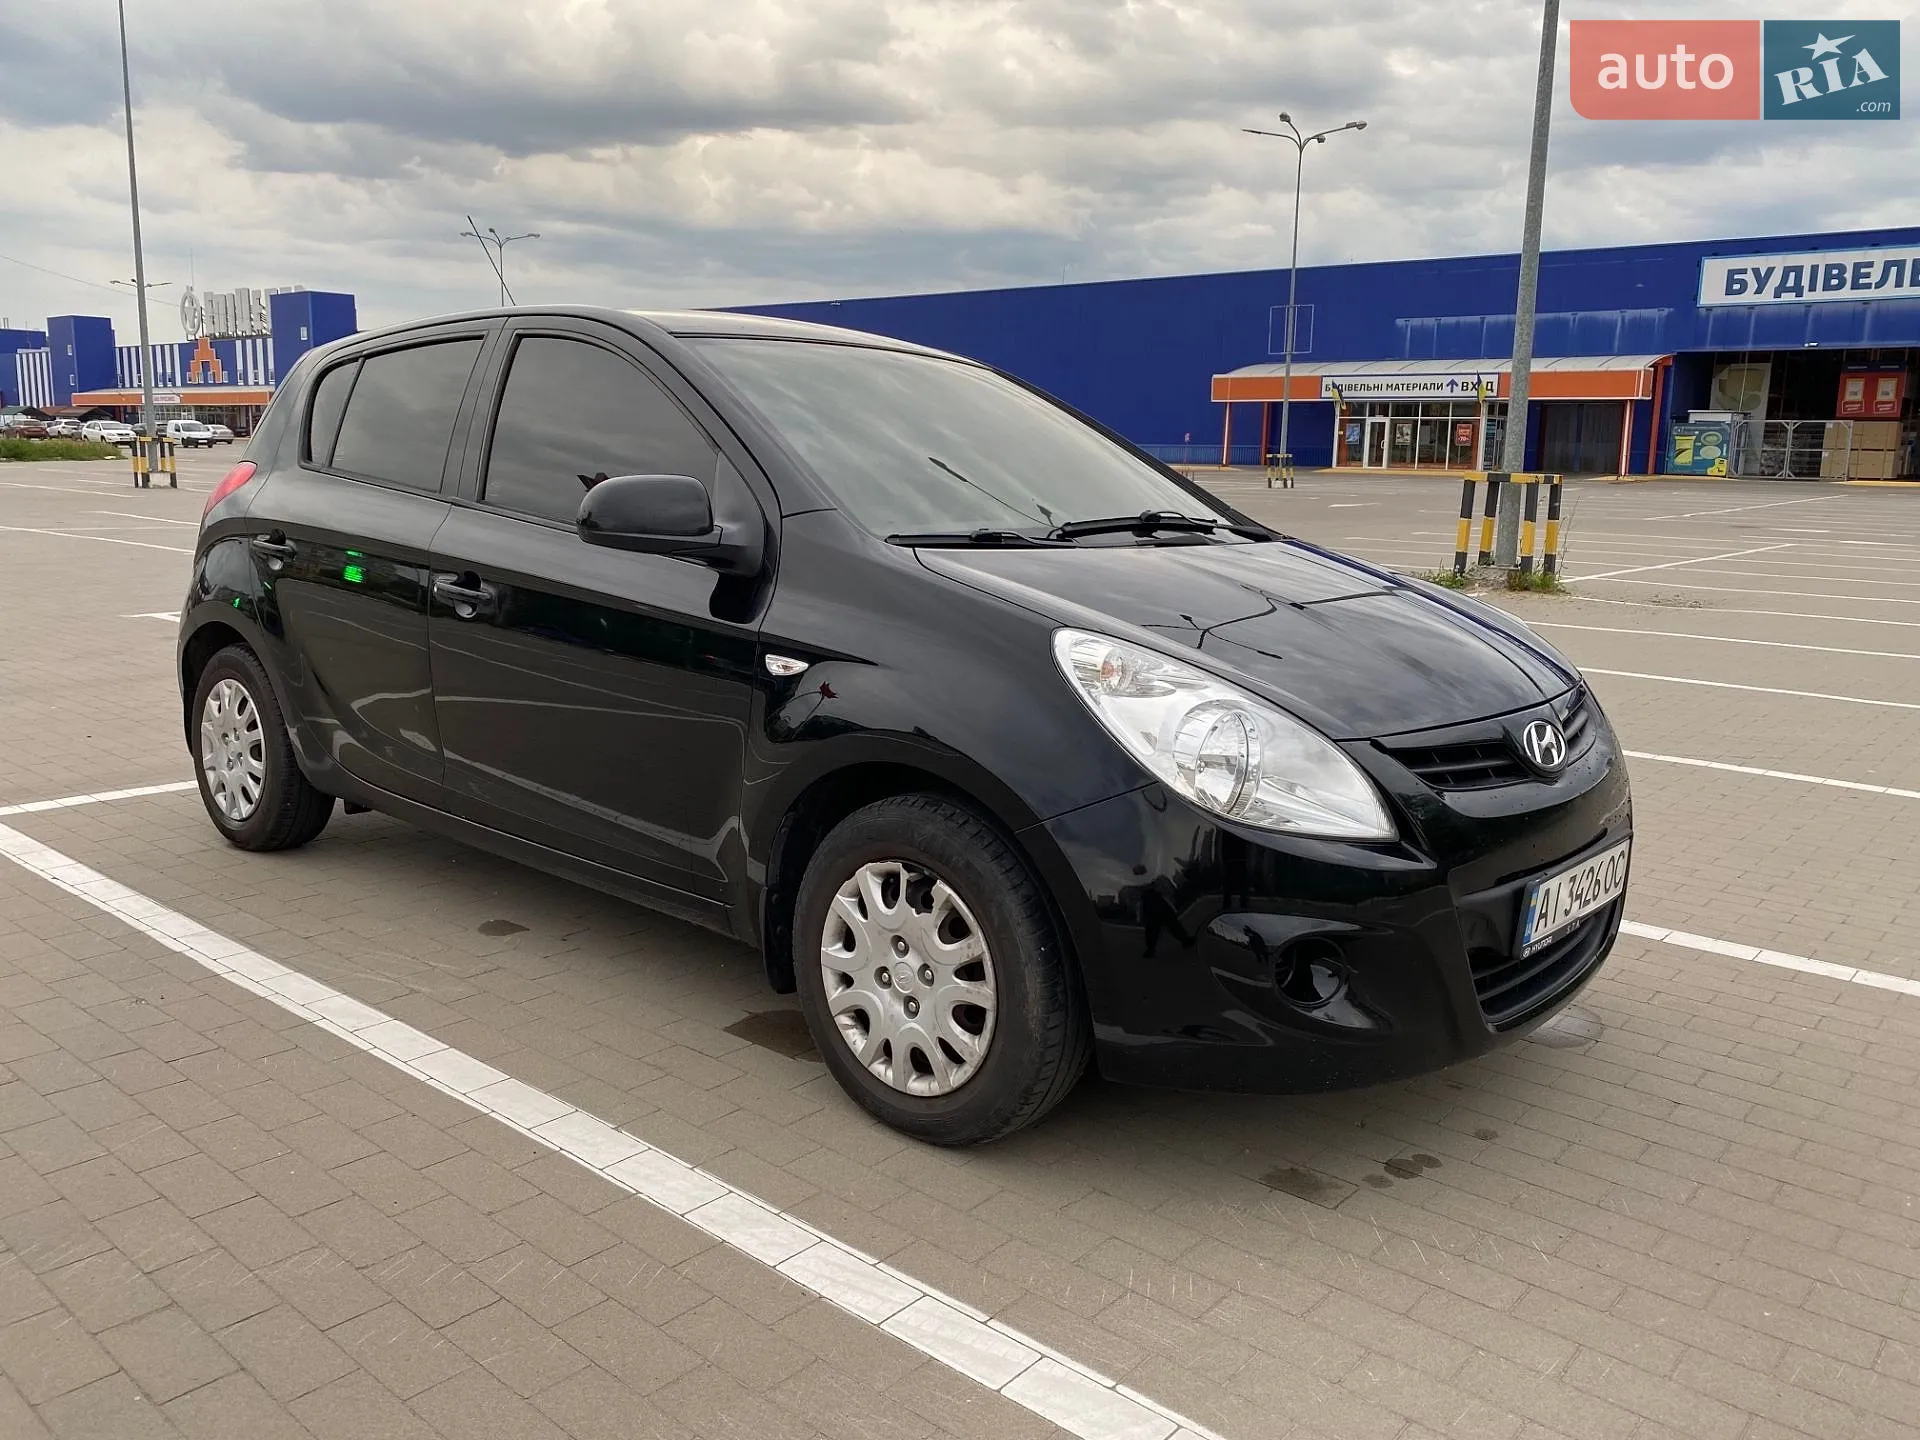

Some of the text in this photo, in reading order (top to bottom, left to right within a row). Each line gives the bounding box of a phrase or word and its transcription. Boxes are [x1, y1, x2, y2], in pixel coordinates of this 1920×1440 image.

[1325, 382, 1444, 392] БДІВЕЛЬНІ МАТЕРІАЛИ
[1461, 381, 1494, 393] ВХД
[1564, 860, 1604, 917] 3426
